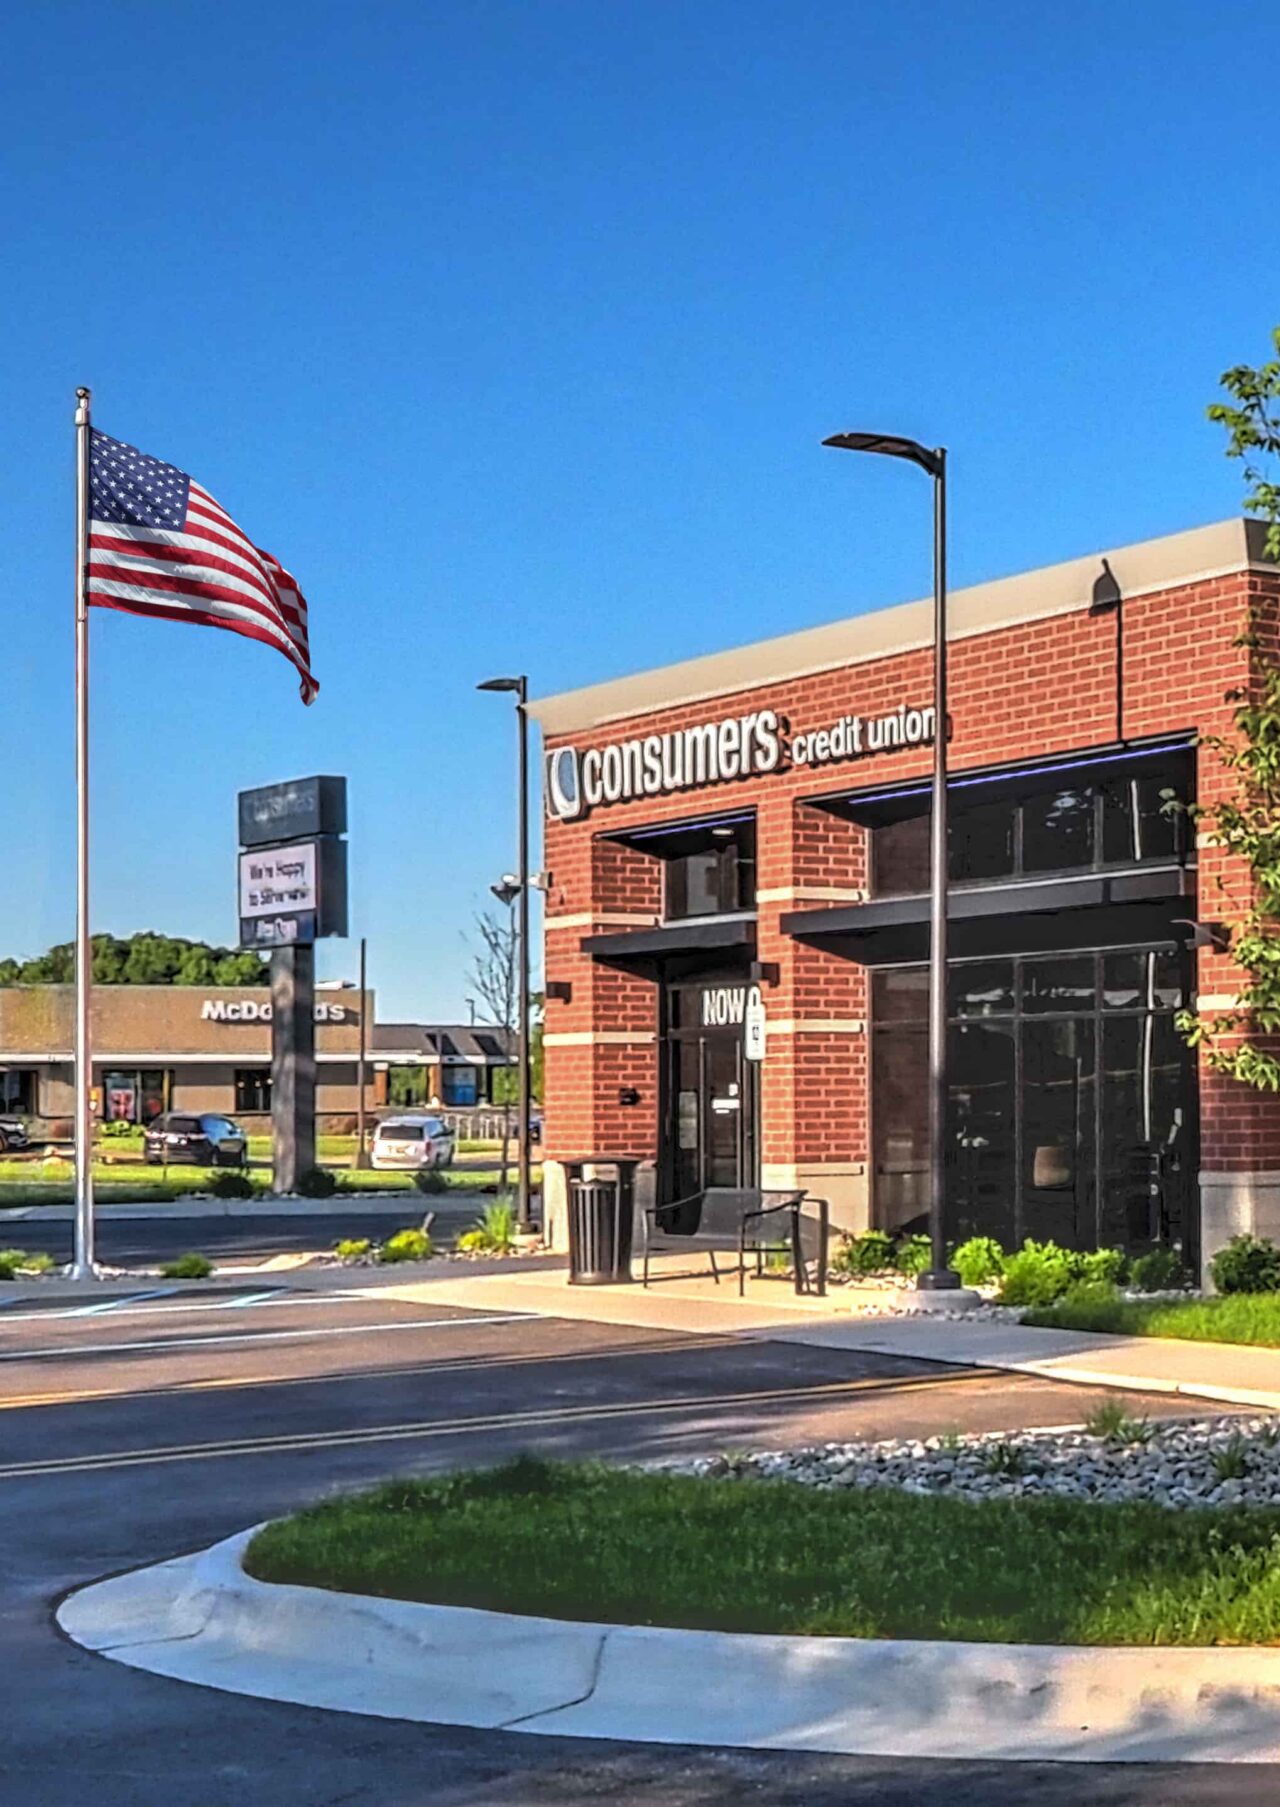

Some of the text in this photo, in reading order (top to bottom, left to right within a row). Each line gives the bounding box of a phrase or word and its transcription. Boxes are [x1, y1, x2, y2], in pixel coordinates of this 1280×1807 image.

[583, 709, 780, 805] consumers
[792, 704, 936, 765] credit union
[702, 986, 746, 1026] NOW
